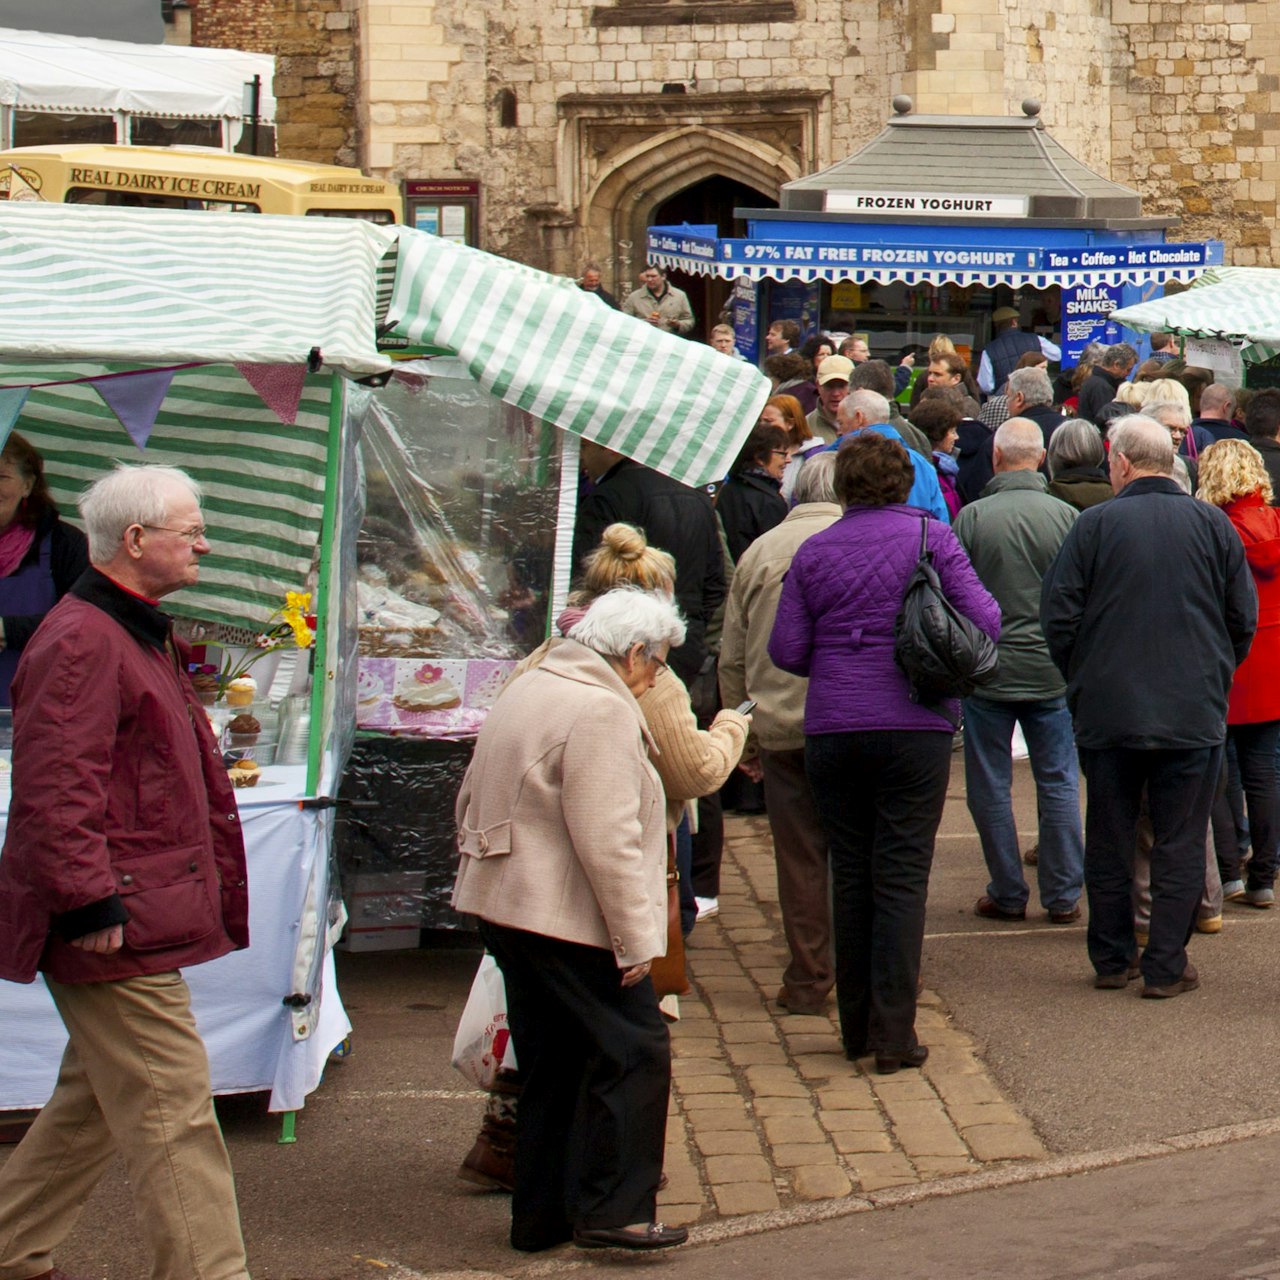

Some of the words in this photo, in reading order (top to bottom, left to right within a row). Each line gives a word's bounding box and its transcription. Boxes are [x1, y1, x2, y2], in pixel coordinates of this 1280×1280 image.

[71, 168, 115, 186] REAL
[117, 172, 167, 191] DAIRY
[171, 177, 200, 194] ICE
[201, 179, 261, 199] CREAM
[310, 183, 327, 193] REAL
[328, 184, 348, 194] DAIRY
[349, 184, 360, 194] ICE
[361, 185, 385, 195] CREAM
[857, 197, 915, 209] FROZEN
[921, 198, 993, 212] YOGHURT
[649, 234, 658, 248] Tea
[662, 236, 677, 252] Coffee
[681, 240, 691, 253] Hot
[691, 241, 714, 258] Chocolate
[744, 245, 781, 259] 97%
[784, 246, 814, 261] FAT
[818, 247, 858, 261] FREE
[862, 248, 929, 264] FROZEN
[932, 250, 1016, 266] YOGHURT
[1050, 253, 1069, 267] Tea
[1081, 251, 1116, 266] Coffee
[1128, 251, 1146, 264] Hot
[1149, 249, 1201, 264] Chocolate
[1076, 288, 1109, 301] MILK
[1066, 299, 1118, 315] SHAKES
